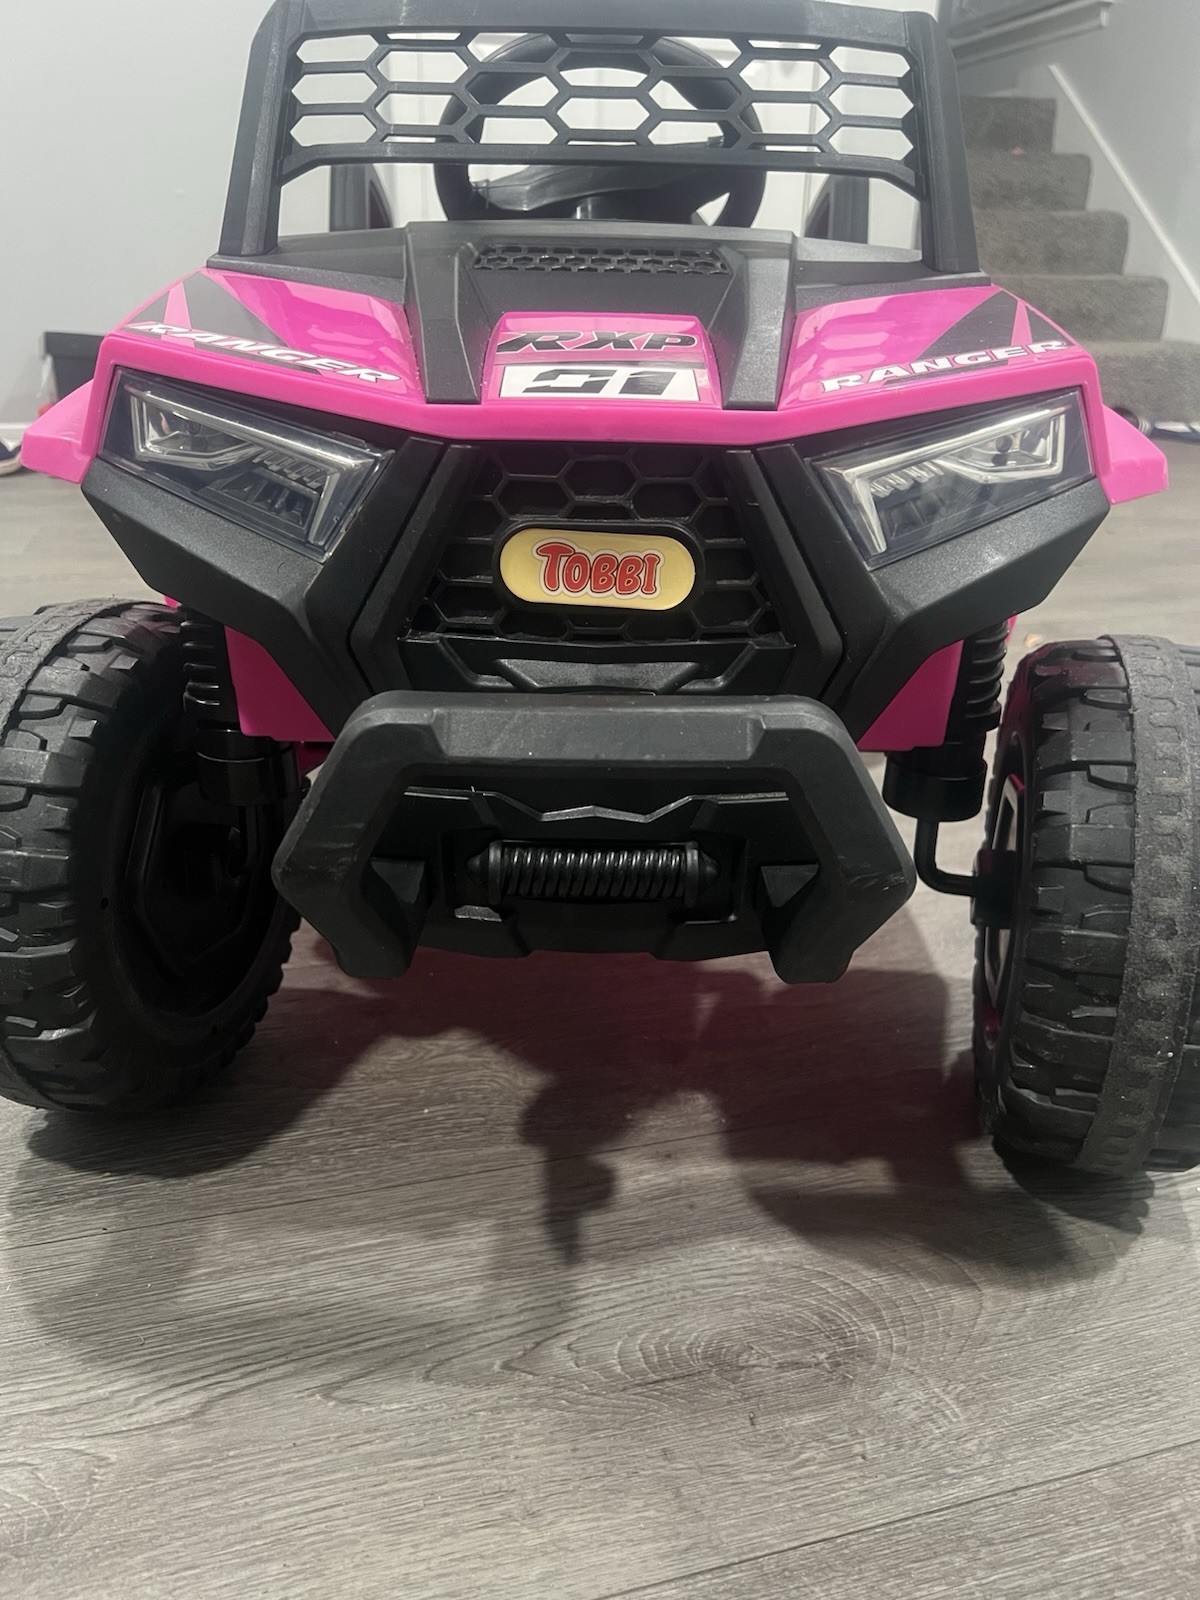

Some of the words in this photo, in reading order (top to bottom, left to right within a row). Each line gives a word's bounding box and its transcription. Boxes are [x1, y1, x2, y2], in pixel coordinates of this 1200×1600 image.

[126, 323, 402, 383] RANGER
[496, 331, 698, 353] RXP
[821, 340, 1069, 392] RANGER
[534, 540, 661, 595] TOBBI
